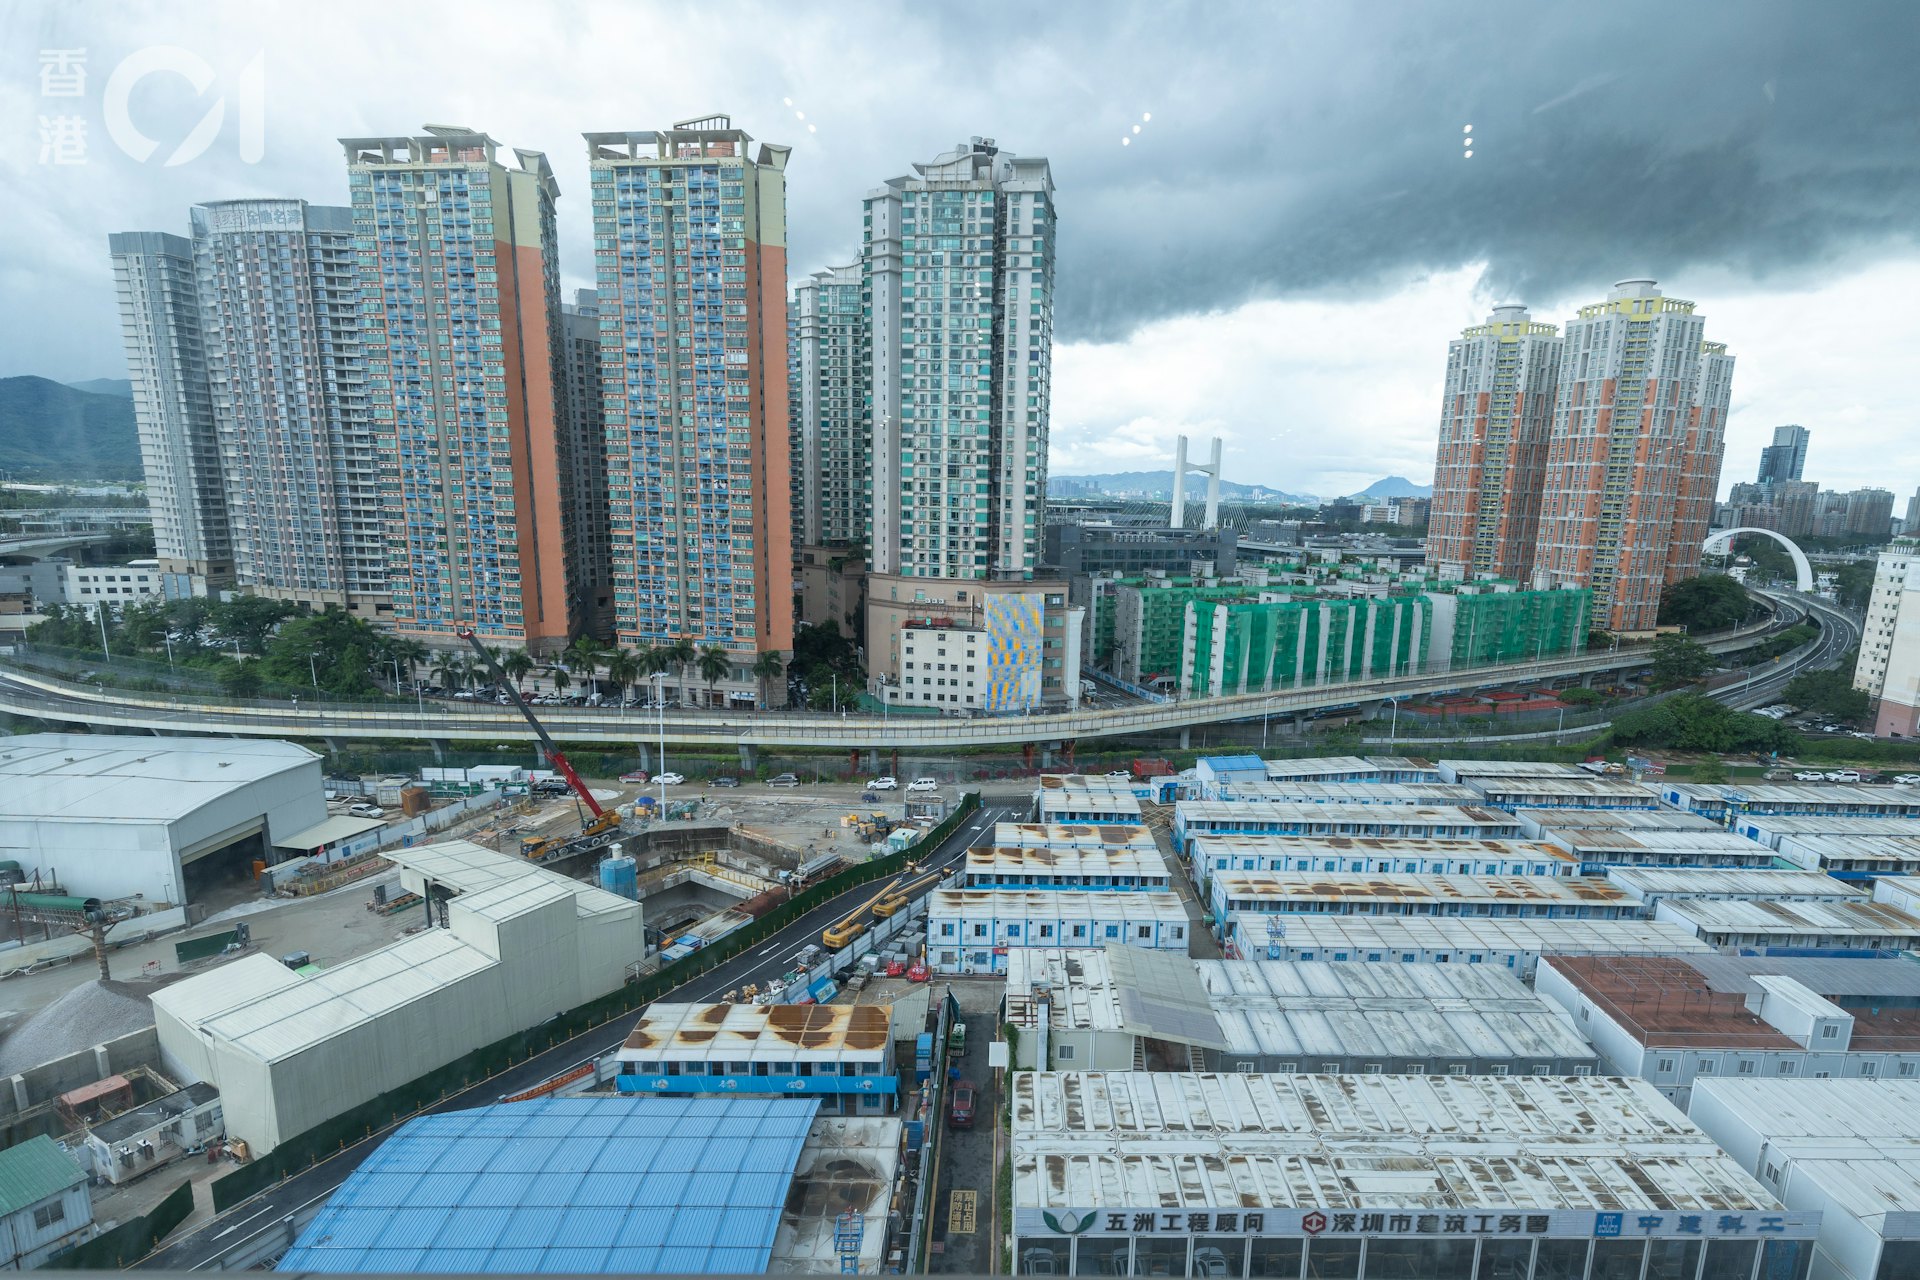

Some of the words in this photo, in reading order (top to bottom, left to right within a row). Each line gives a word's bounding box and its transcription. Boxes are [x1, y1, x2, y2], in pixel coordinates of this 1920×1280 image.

[951, 1192, 963, 1231] 消防通道
[963, 1192, 974, 1231] 禁止占用
[1105, 1212, 1264, 1233] 五洲工程顾问
[1331, 1213, 1550, 1234] 深圳市建筑工务署
[1637, 1215, 1785, 1234] 中建科工
